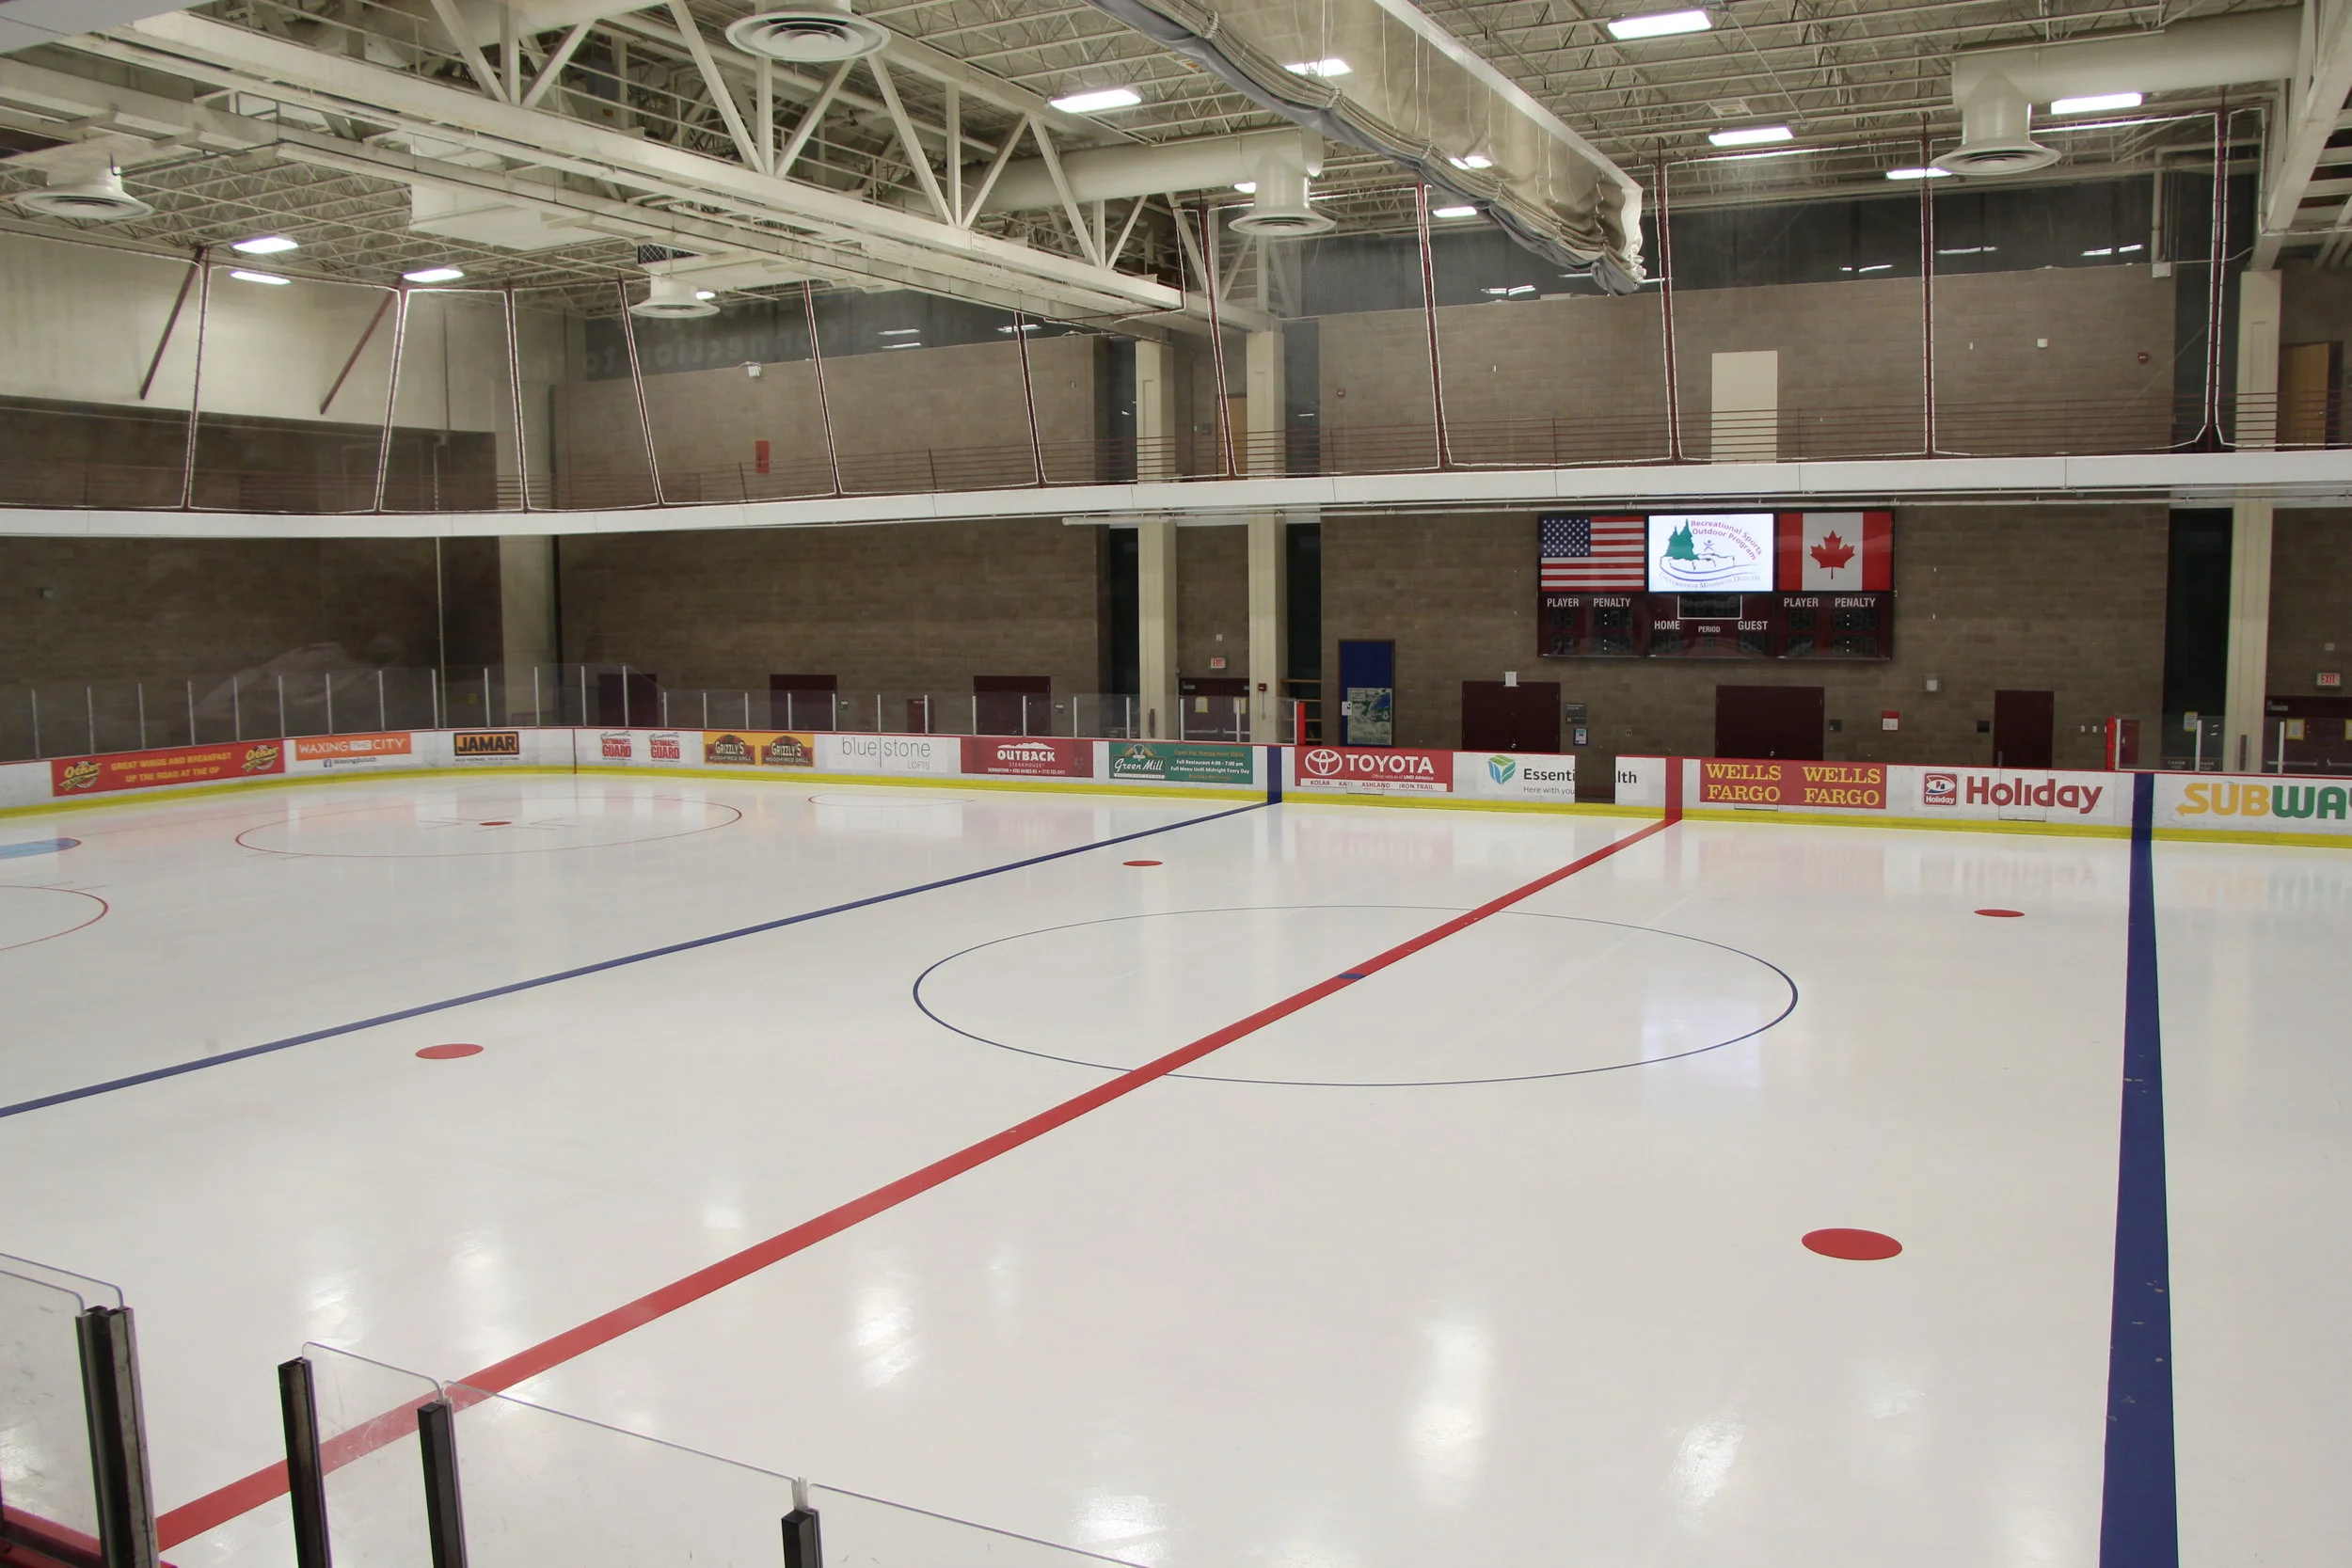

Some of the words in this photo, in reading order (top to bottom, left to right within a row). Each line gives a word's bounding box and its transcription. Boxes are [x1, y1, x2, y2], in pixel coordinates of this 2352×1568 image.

[1691, 520, 1742, 535] Recreational
[1741, 531, 1762, 555] Sports
[1692, 528, 1726, 537] Outdoor
[1728, 532, 1756, 561] Program
[1547, 597, 1580, 608] PLAYER
[1593, 597, 1631, 608] PENALTY
[1783, 597, 1819, 608] PLAYER
[1835, 597, 1876, 608] PENALTY
[1654, 620, 1681, 630] HOME
[1738, 620, 1769, 631] GUEST
[299, 740, 349, 753] WAXING
[373, 737, 407, 750] CITY
[457, 736, 516, 752] JAMAR
[602, 745, 631, 757] GUARD
[715, 741, 745, 755] GRIZZLY'S
[771, 743, 802, 757] GRIZZLY'S
[651, 747, 679, 758] GUARD
[997, 749, 1056, 762] OUTBACK
[111, 760, 137, 771] GREAT
[140, 758, 167, 768] WINGS
[169, 756, 185, 765] AND
[186, 752, 232, 764] BREAKFAST
[908, 760, 930, 769] LOFTS
[1114, 758, 1142, 772] Green
[1141, 759, 1164, 770] Mill
[1345, 754, 1435, 774] TOYOTA
[125, 774, 136, 783] UP
[138, 772, 154, 781] THE
[156, 770, 179, 780] ROAD
[181, 768, 190, 777] AT
[192, 768, 208, 776] THE
[1706, 763, 1782, 781] WELLS
[1803, 766, 1882, 784] WELLS
[1523, 785, 1541, 794] Here
[1542, 786, 1560, 795] with
[1708, 784, 1781, 801] FARGO
[1804, 787, 1880, 806] FARGO
[1966, 776, 2104, 814] Holiday
[1926, 795, 1955, 805] Holiday
[2175, 783, 2352, 820] SUBWA
